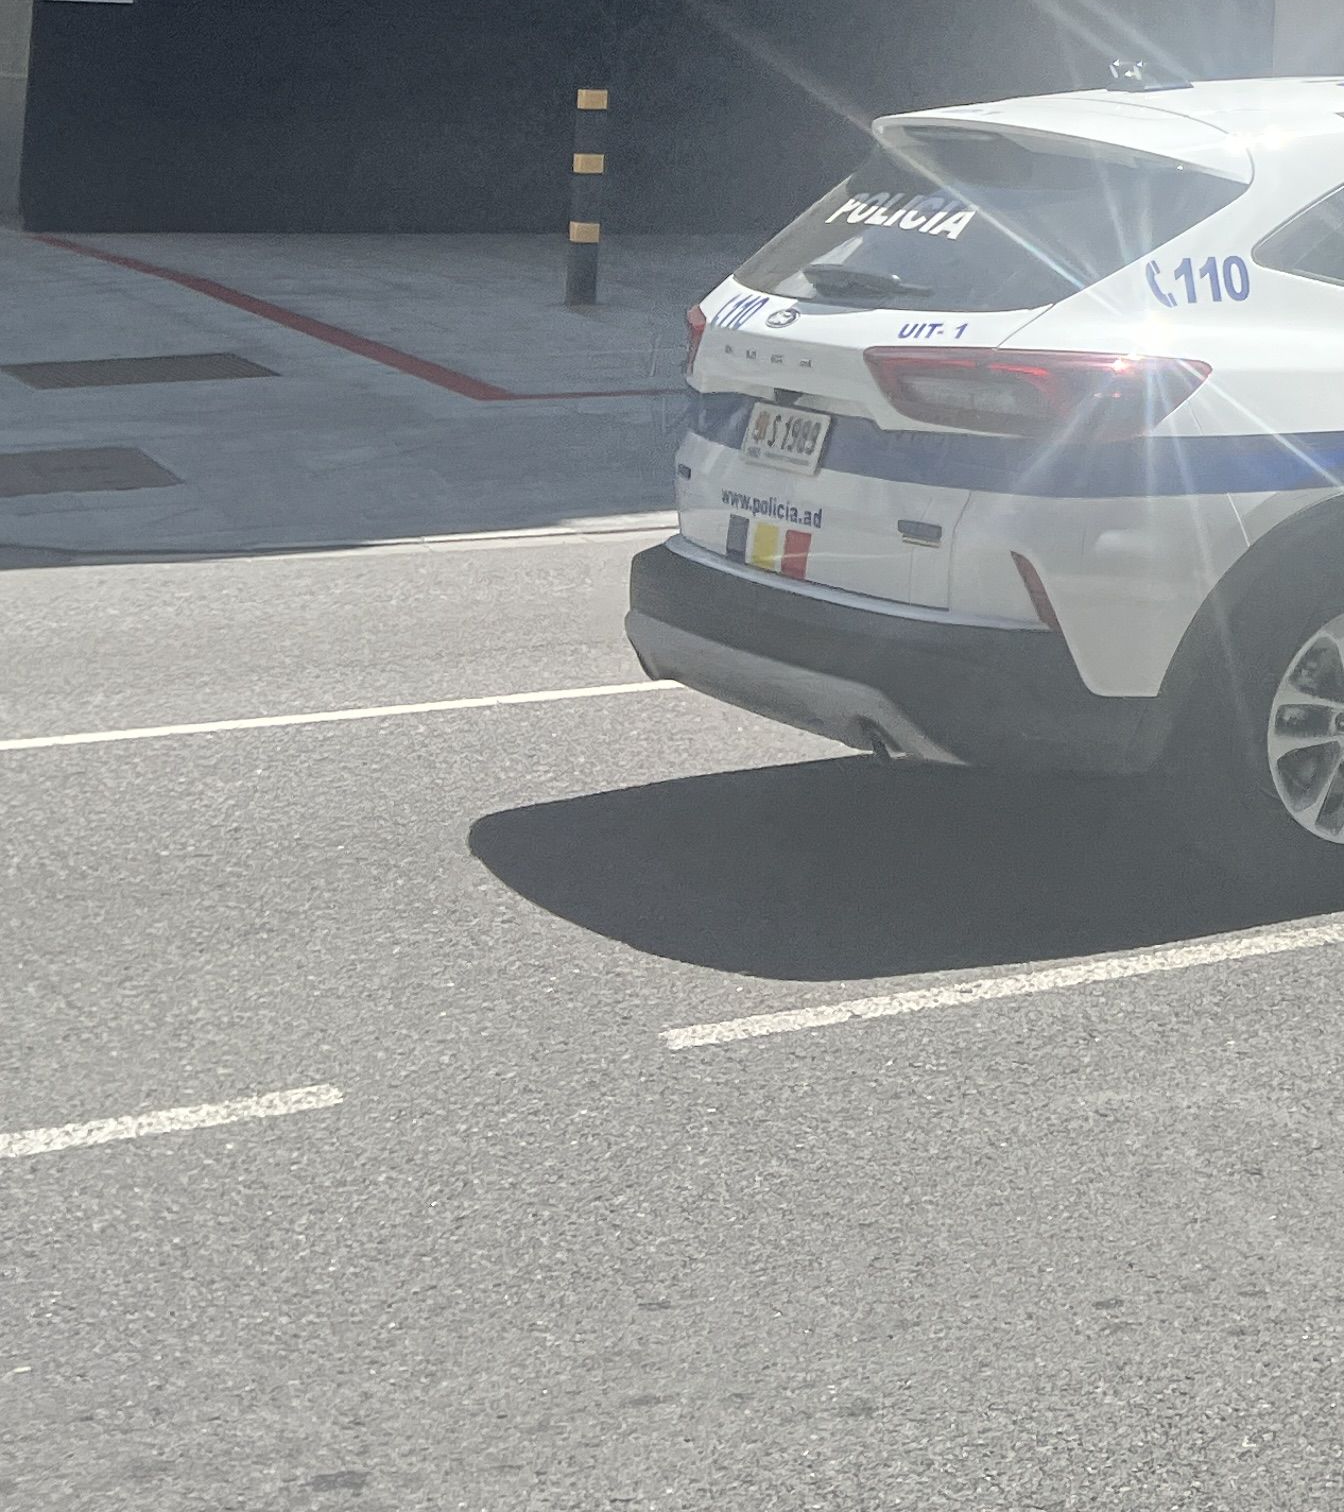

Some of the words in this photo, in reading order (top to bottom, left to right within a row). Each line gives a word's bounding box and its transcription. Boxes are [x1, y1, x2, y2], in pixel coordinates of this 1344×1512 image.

[825, 193, 979, 241] POLICIA
[1174, 255, 1251, 303] 110
[954, 323, 968, 339] 1
[721, 488, 823, 528] www.policia.ad
